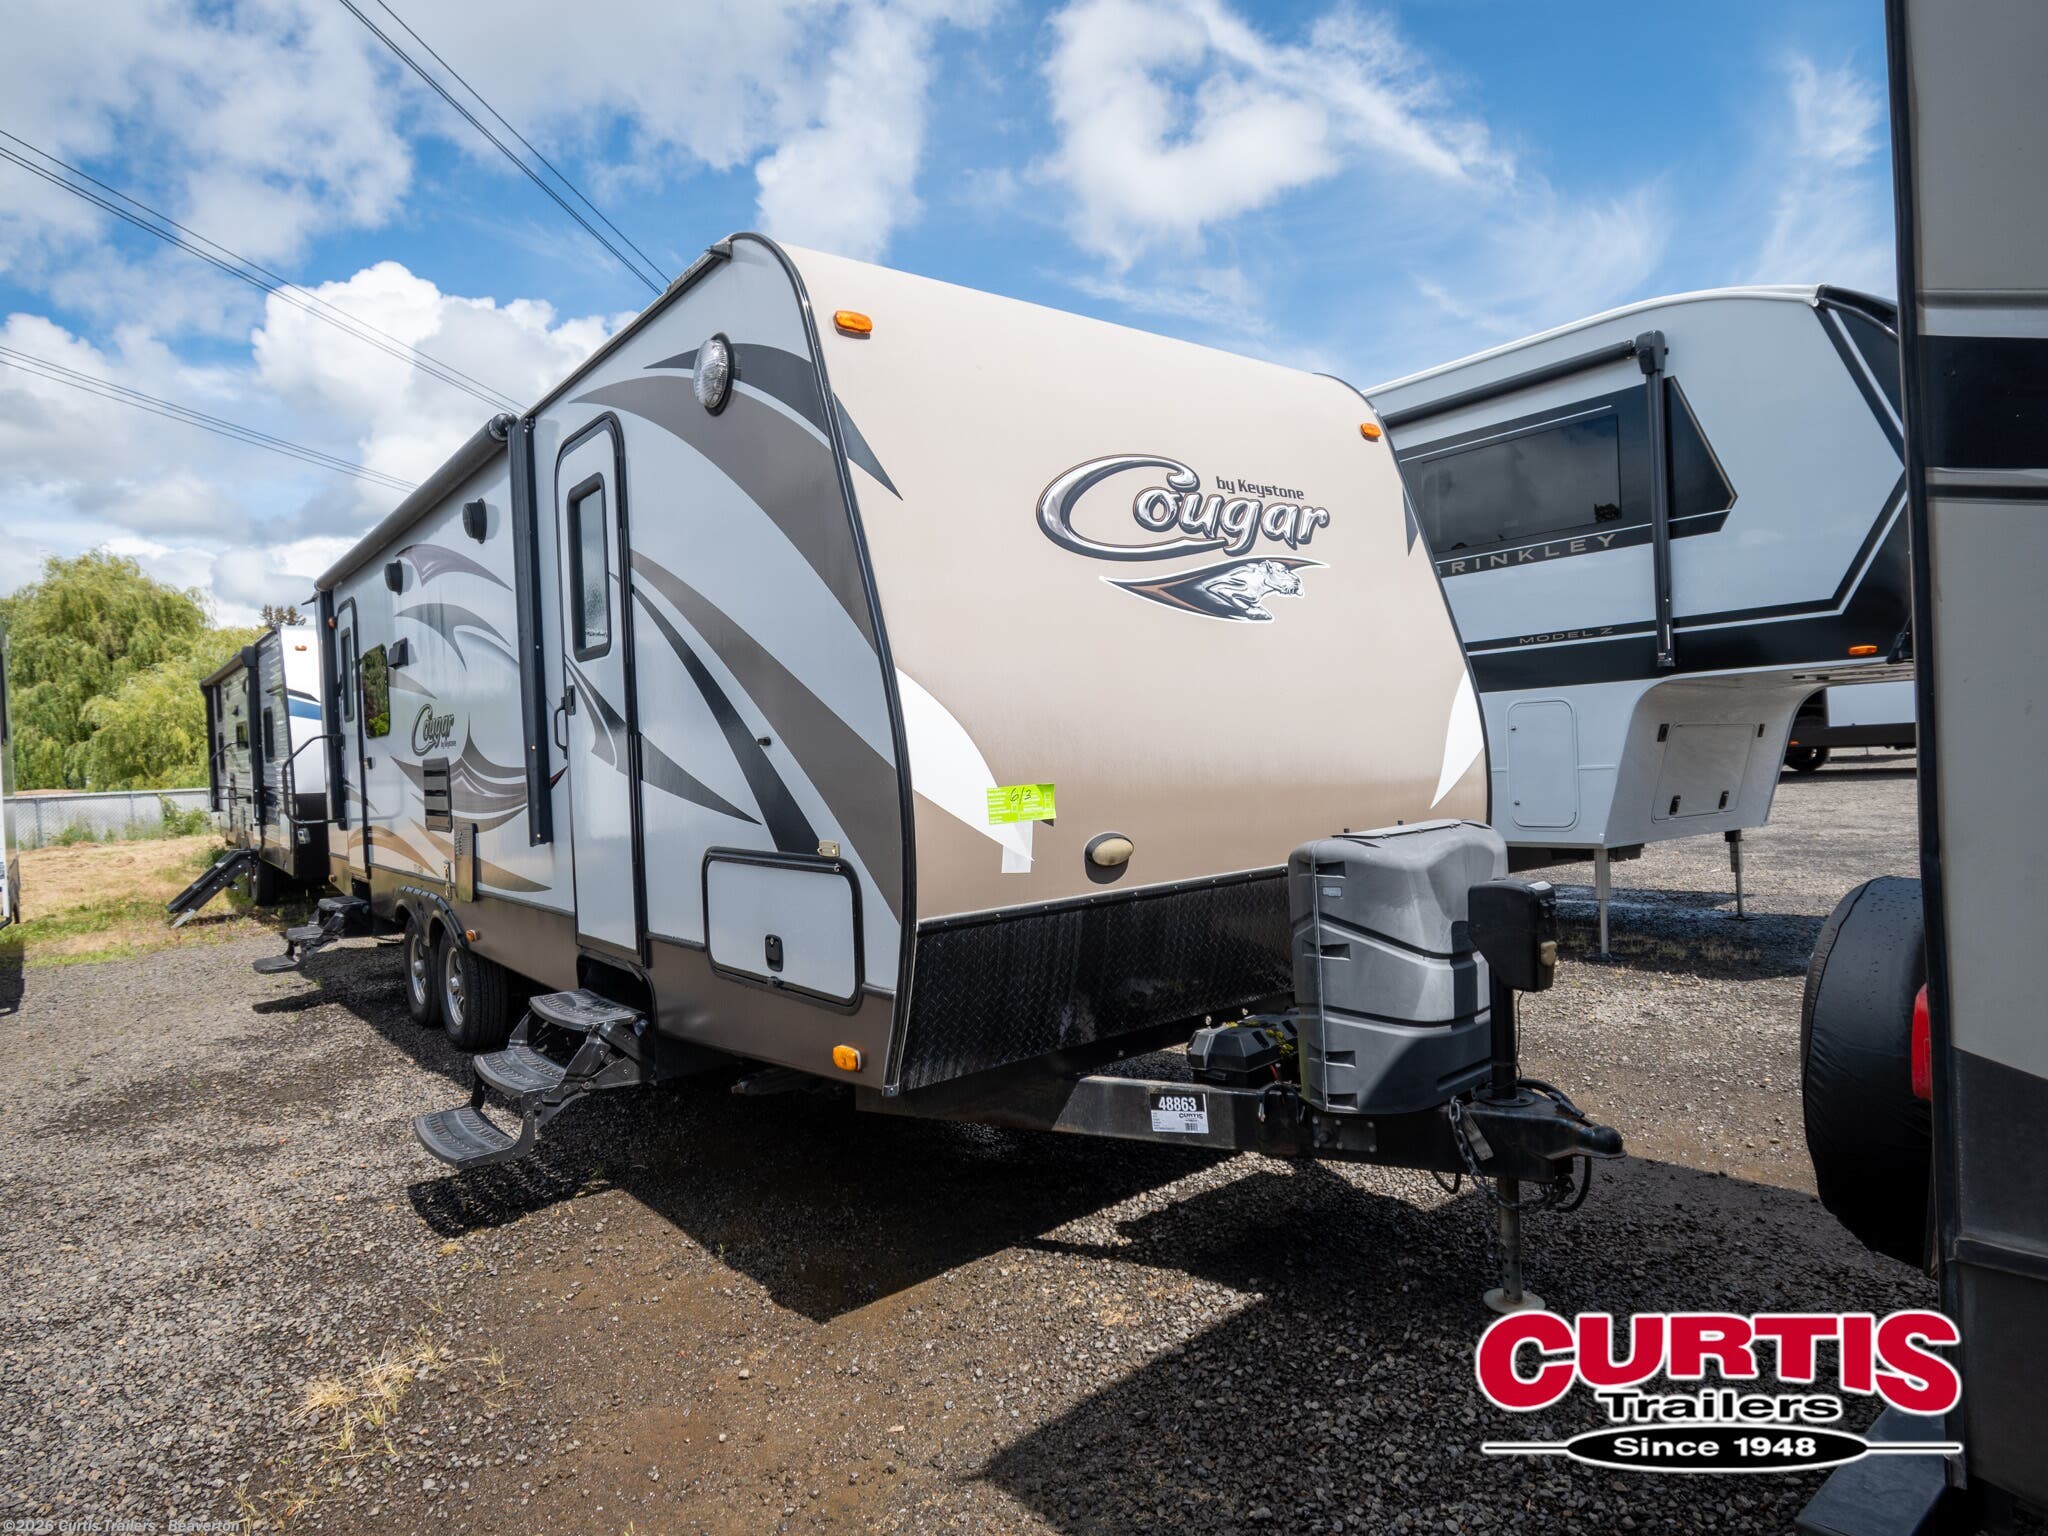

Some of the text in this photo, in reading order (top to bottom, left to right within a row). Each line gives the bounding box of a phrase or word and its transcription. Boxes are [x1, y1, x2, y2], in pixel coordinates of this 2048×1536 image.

[1216, 475, 1305, 500] by Keystone
[1036, 453, 1330, 562] Cougar
[1519, 627, 1614, 644] MODEL Z
[411, 703, 455, 757] Cougar
[1158, 1096, 1197, 1112] 48863
[1179, 1112, 1203, 1120] CURTIS
